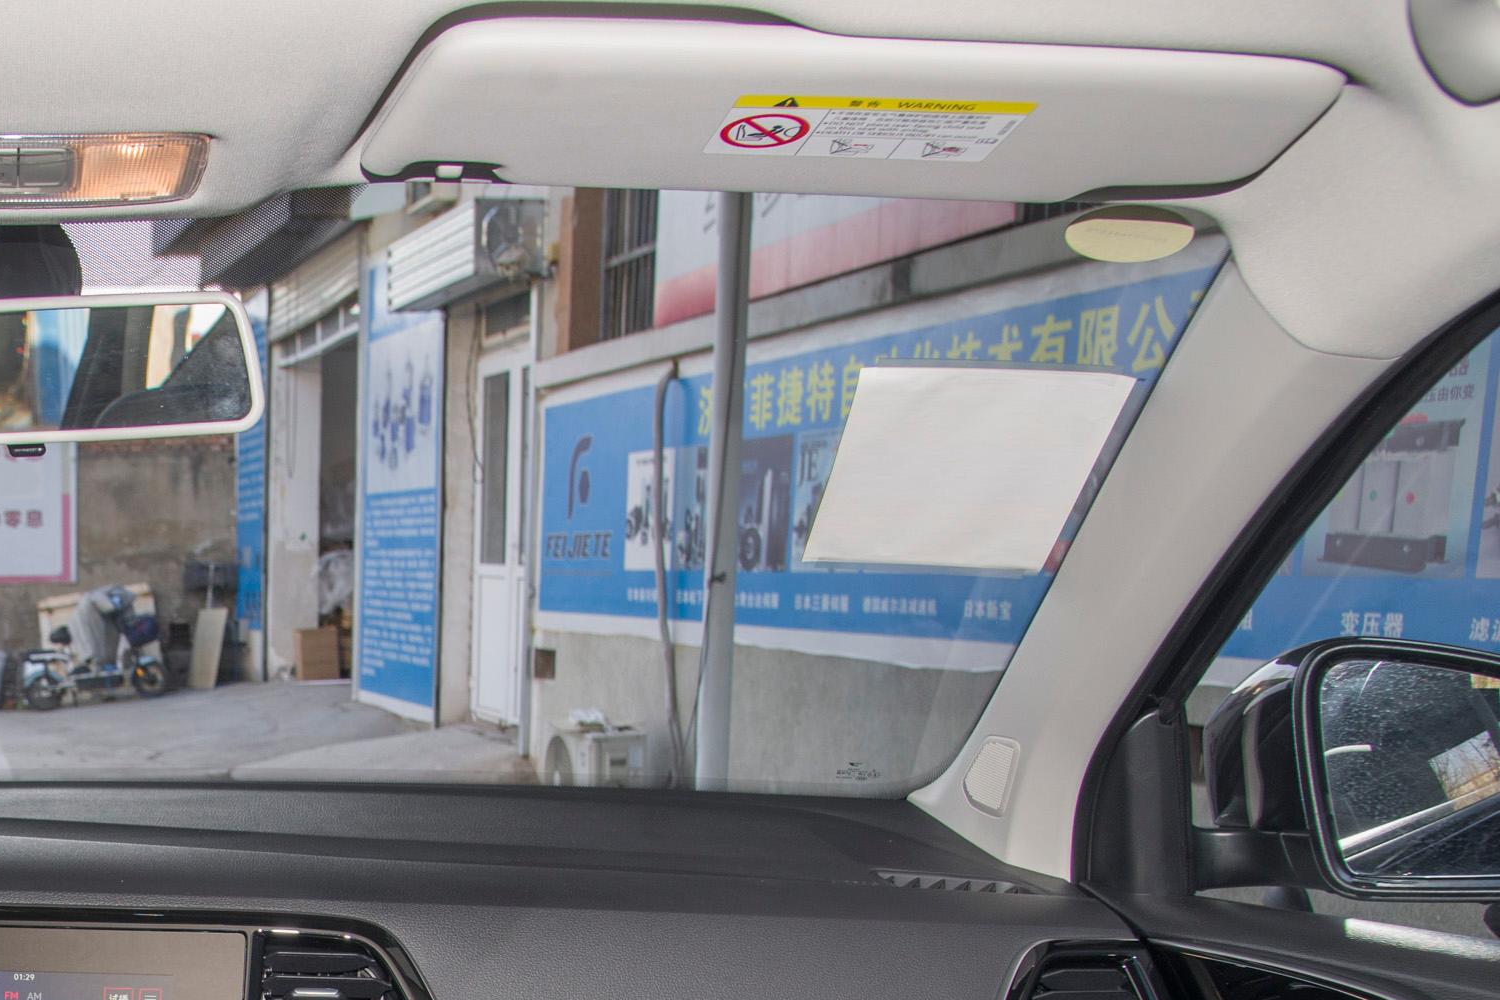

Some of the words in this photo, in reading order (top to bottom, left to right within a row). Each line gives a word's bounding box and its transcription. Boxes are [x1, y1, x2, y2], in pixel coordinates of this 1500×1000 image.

[897, 101, 978, 112] WARNING
[698, 290, 1202, 435] 济菲捷特自术有限公
[1340, 610, 1404, 638] 变压器
[13, 973, 36, 981] 01:29
[4, 991, 19, 1000] FM
[27, 992, 42, 1000] AM
